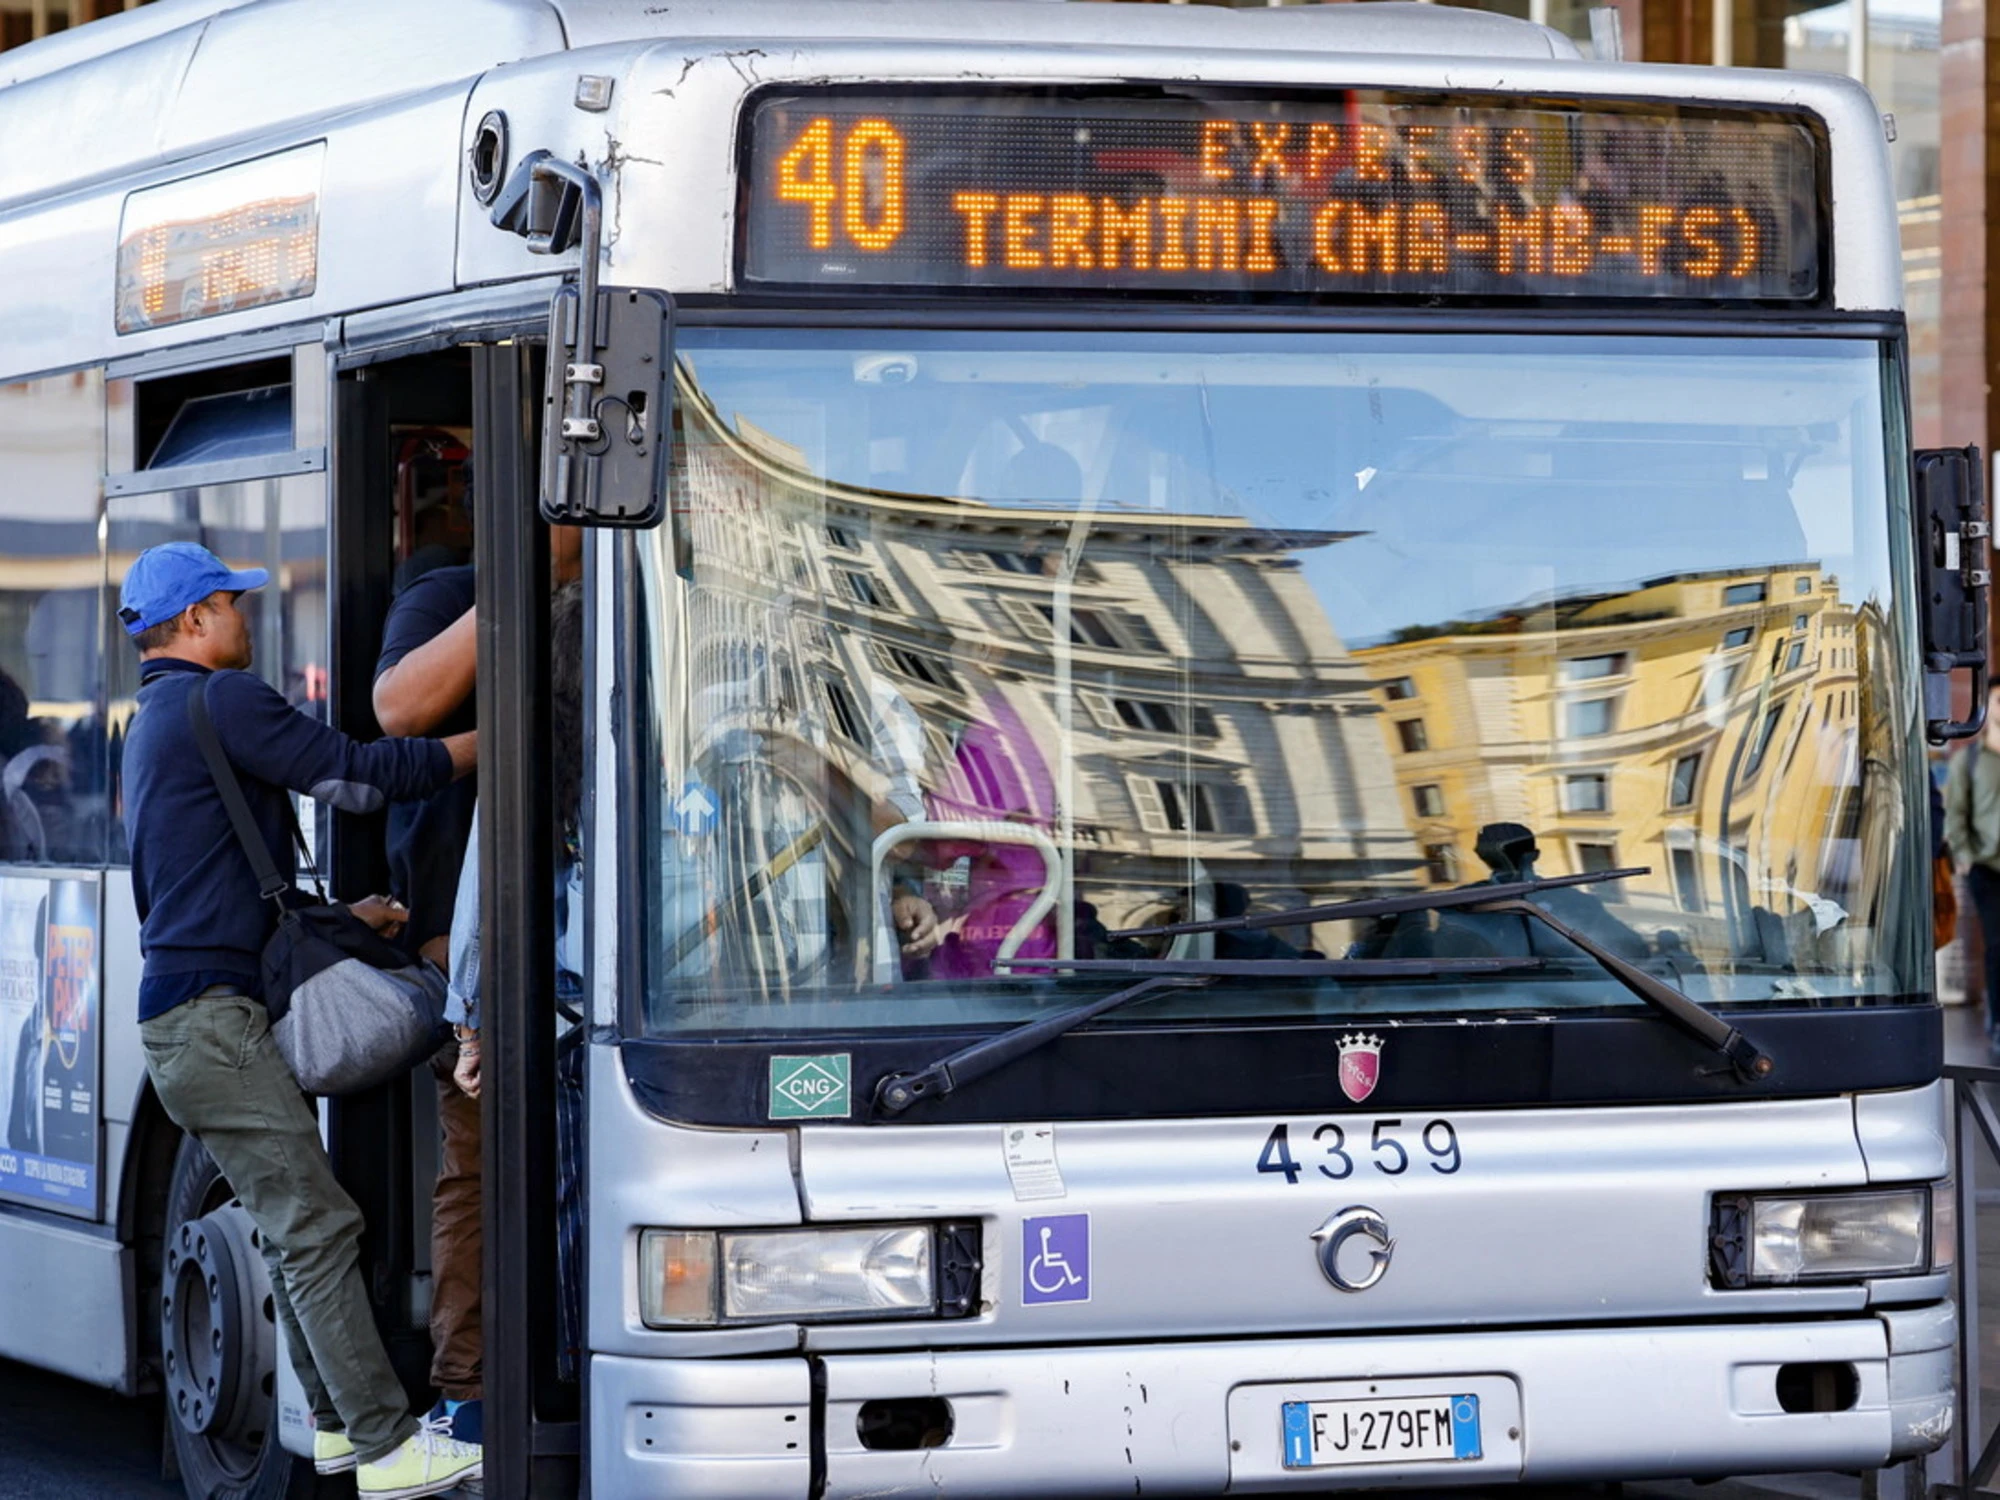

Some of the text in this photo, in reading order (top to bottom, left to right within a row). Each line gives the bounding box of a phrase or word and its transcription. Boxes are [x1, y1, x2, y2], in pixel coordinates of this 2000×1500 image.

[1202, 120, 1535, 180] EXPRESS
[776, 118, 905, 251] 40
[955, 192, 1760, 277] TERMINI (MA-MB-FS)
[789, 1078, 831, 1095] CNG
[1256, 1118, 1462, 1185] 4359
